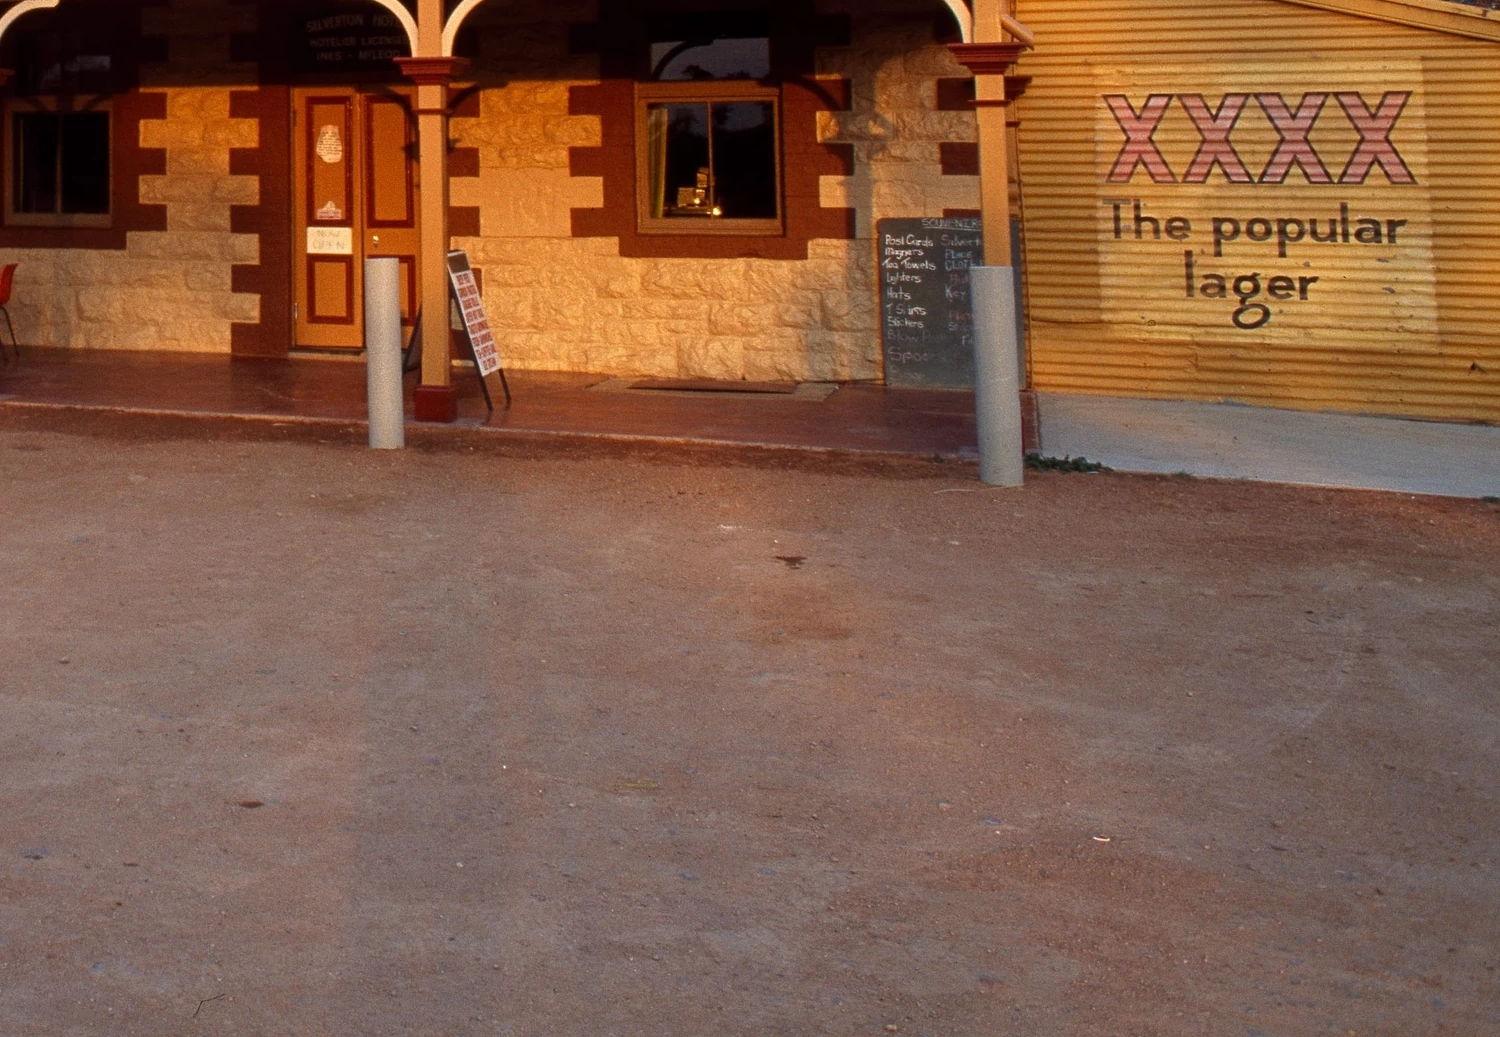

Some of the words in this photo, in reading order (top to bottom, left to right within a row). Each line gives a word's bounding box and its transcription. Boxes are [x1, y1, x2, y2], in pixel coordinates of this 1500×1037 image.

[306, 14, 364, 32] SILVERTON
[1102, 90, 1418, 184] XXXX
[1101, 198, 1192, 241] The
[1212, 202, 1409, 258] popular
[906, 234, 934, 247] Cards
[900, 257, 936, 270] Towels
[886, 286, 912, 301] Hats
[1184, 250, 1319, 330] lager
